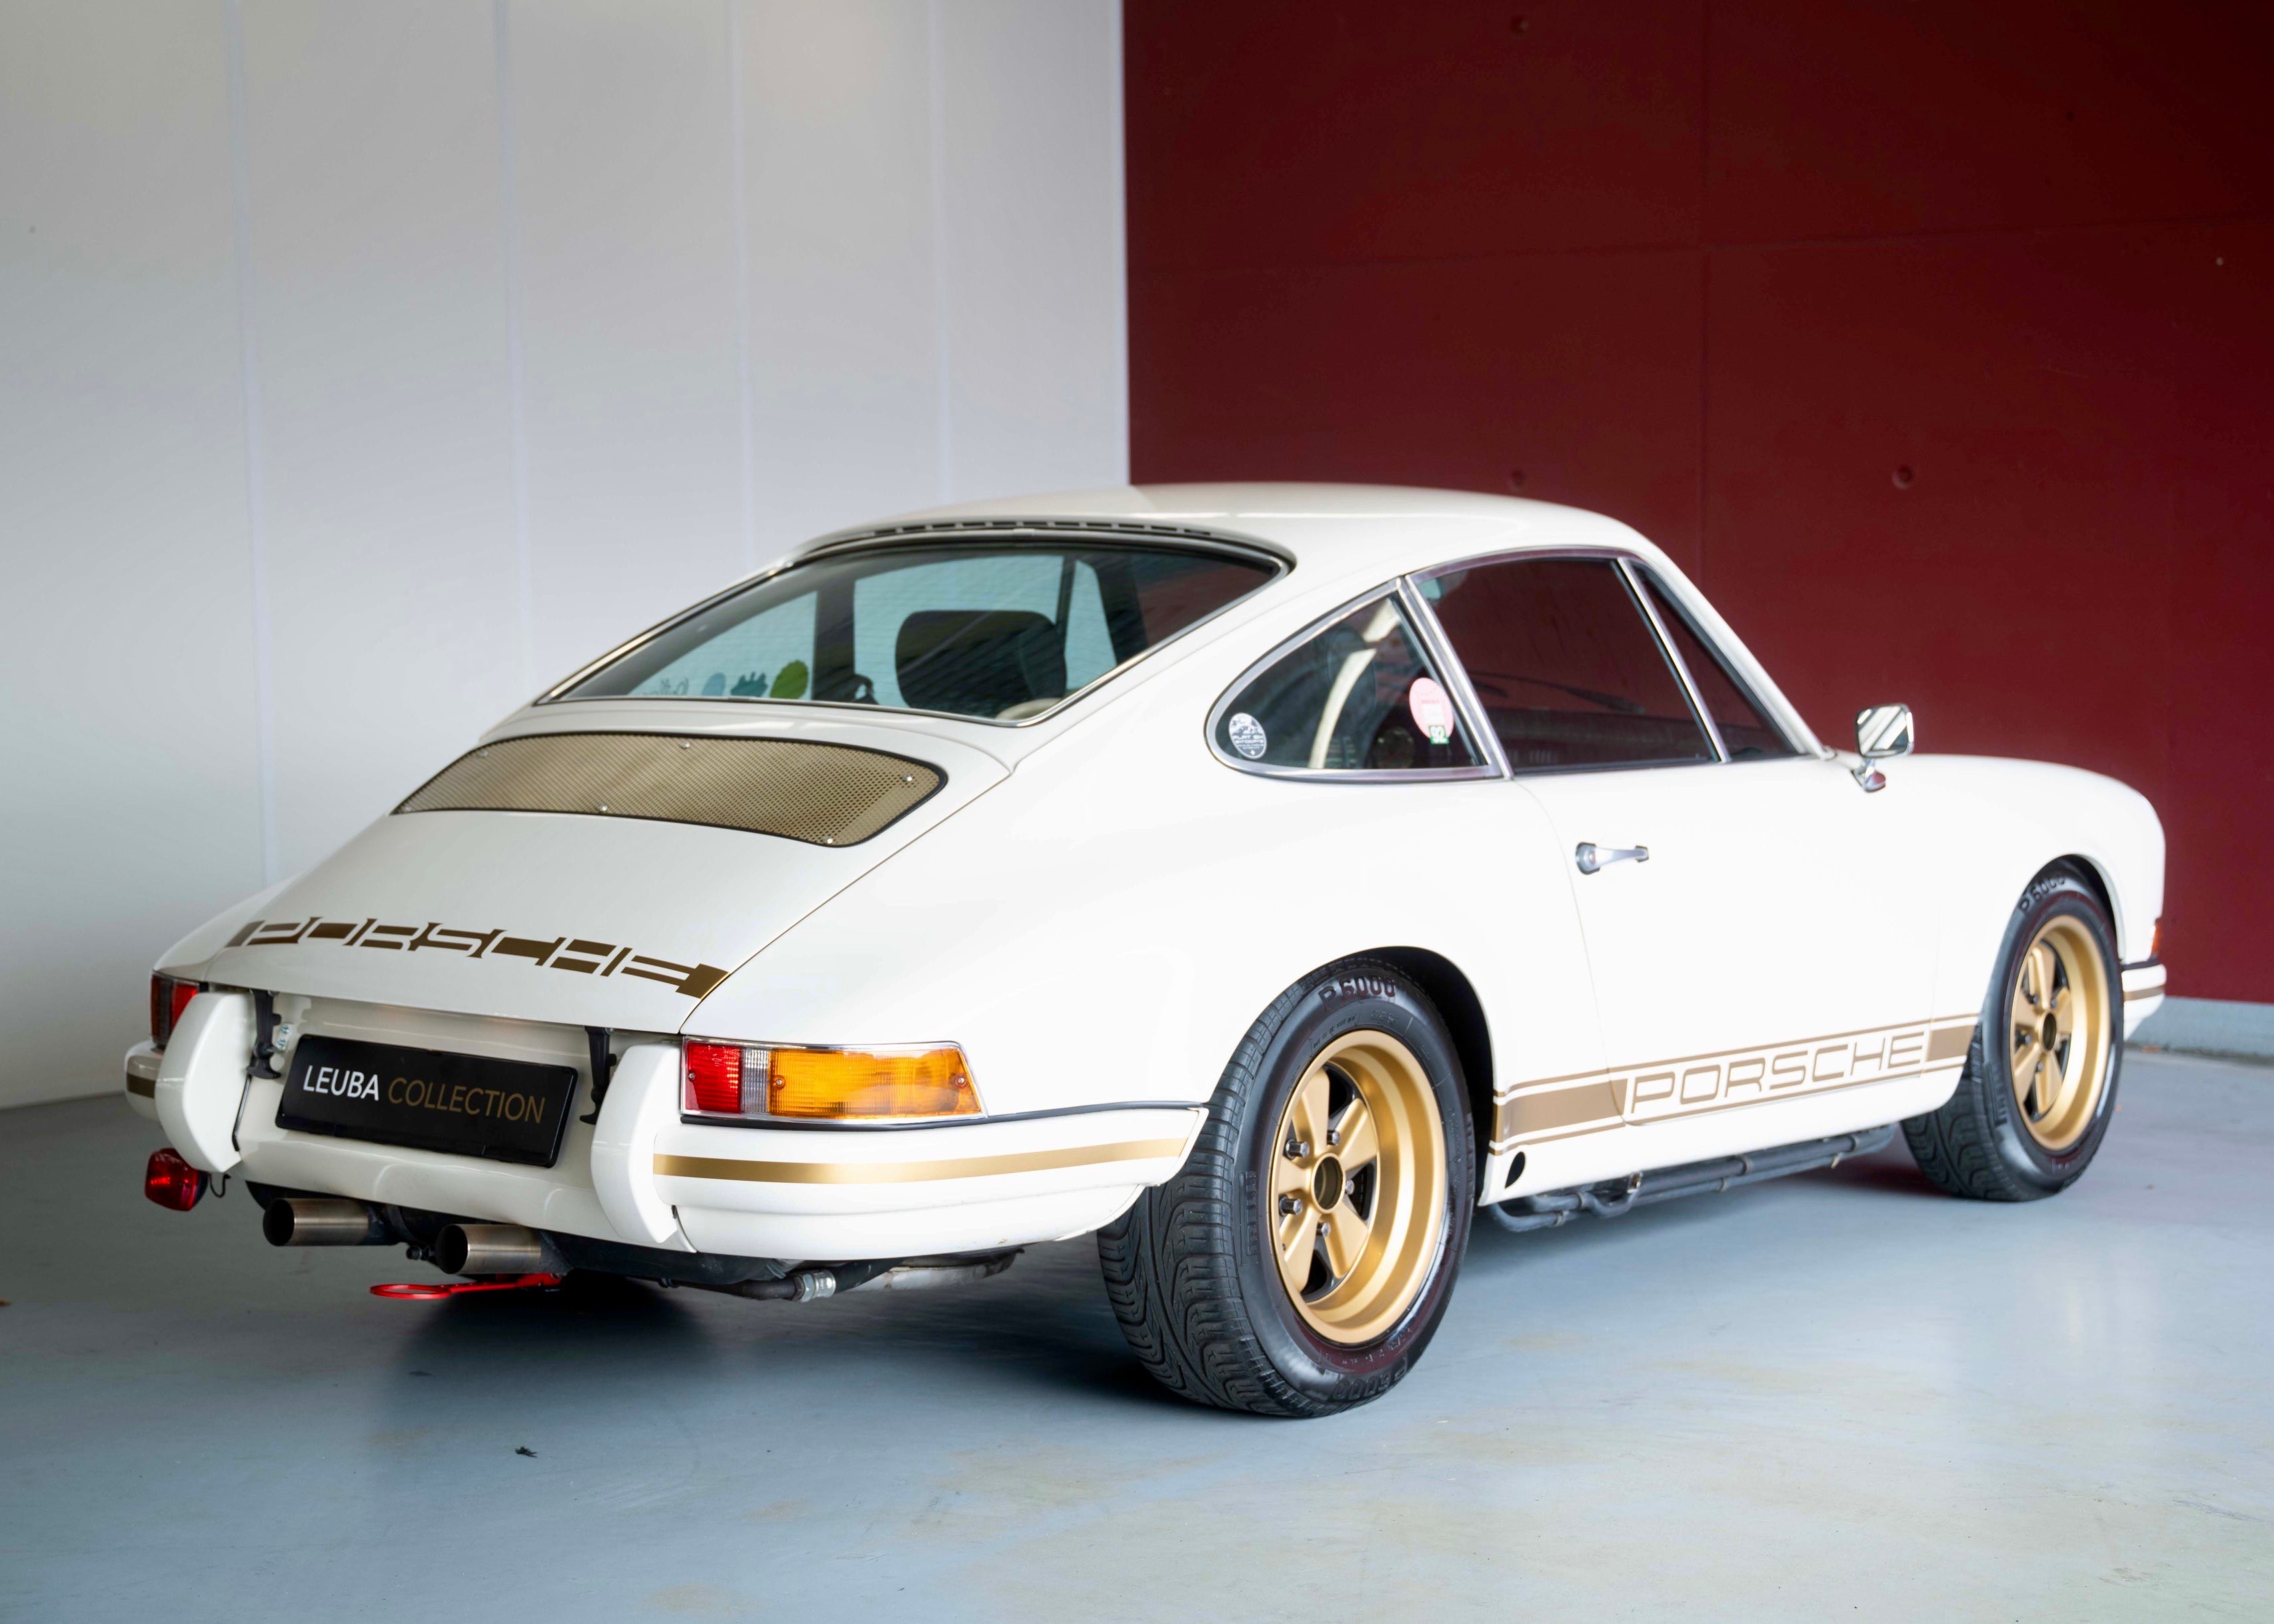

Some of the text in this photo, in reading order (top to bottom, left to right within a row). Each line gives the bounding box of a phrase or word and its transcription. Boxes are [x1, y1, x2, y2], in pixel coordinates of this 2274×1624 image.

[233, 916, 712, 998] PORSCHE
[303, 1065, 546, 1124] LEUBA COLLECTION
[1631, 1032, 1924, 1114] PORSCHE
